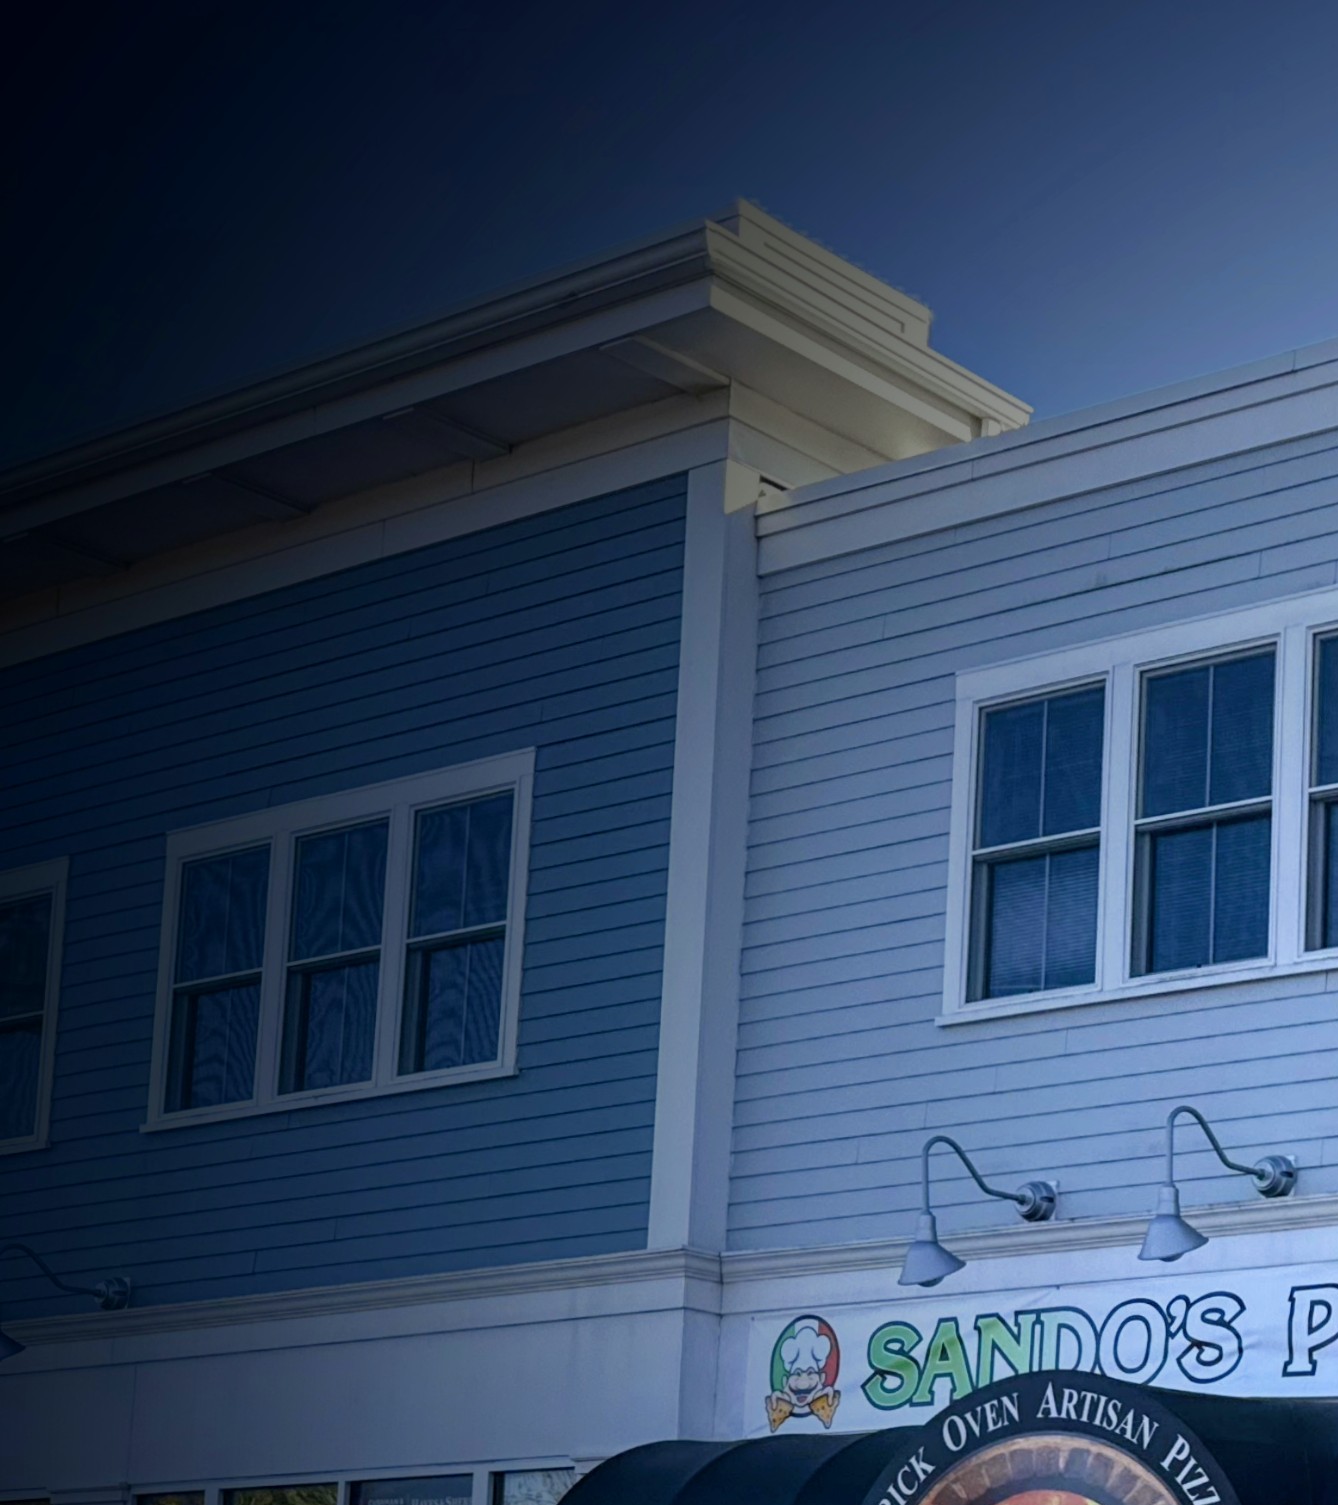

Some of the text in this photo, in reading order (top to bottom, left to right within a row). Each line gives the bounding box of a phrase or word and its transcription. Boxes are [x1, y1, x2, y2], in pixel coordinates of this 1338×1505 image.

[861, 1291, 1247, 1410] SANDO'S
[941, 1391, 1022, 1453] OVEN
[1036, 1381, 1160, 1452] ARTISAN
